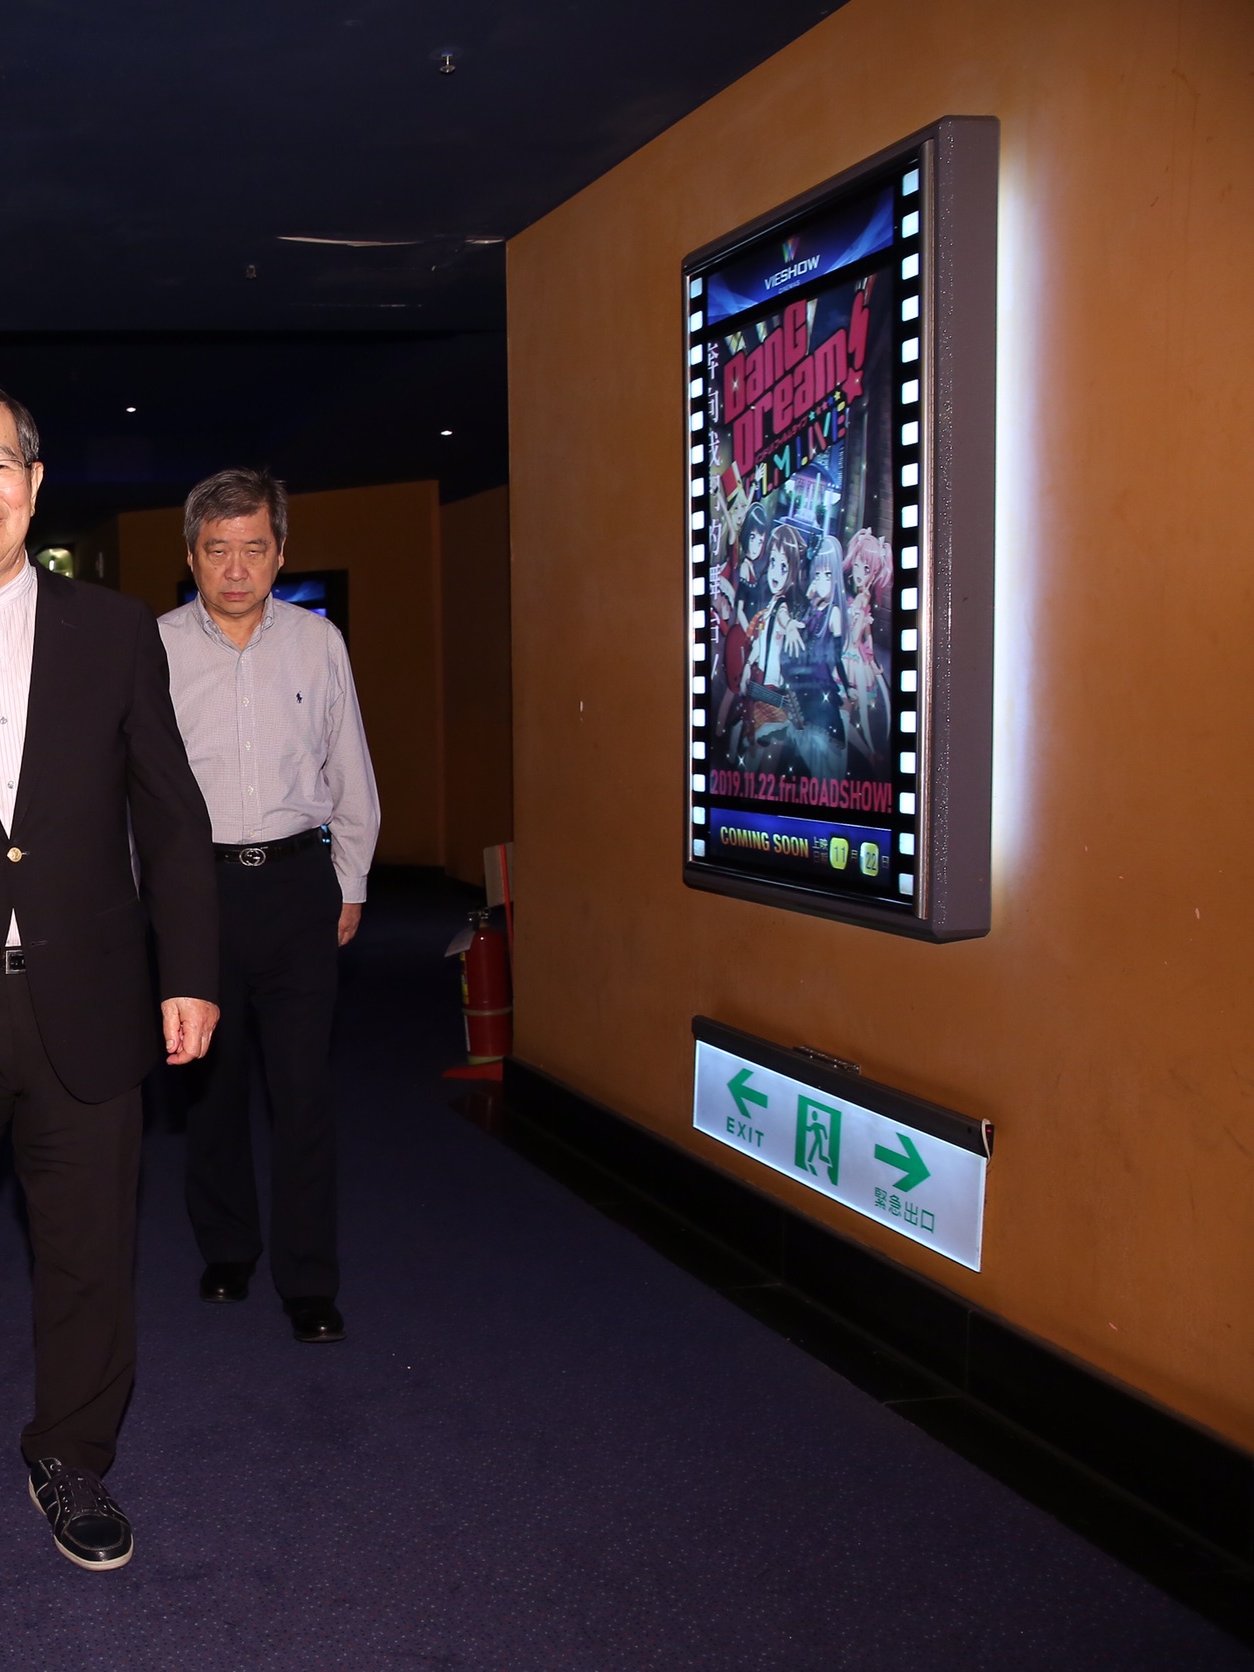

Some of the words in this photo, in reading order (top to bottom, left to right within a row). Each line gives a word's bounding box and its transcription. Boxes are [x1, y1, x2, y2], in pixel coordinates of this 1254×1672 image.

[764, 255, 821, 290] VIESHOW
[720, 826, 770, 851] COMING
[773, 833, 809, 858] SOON
[726, 1116, 764, 1148] EXIT
[874, 1186, 935, 1234] 緊急出口
